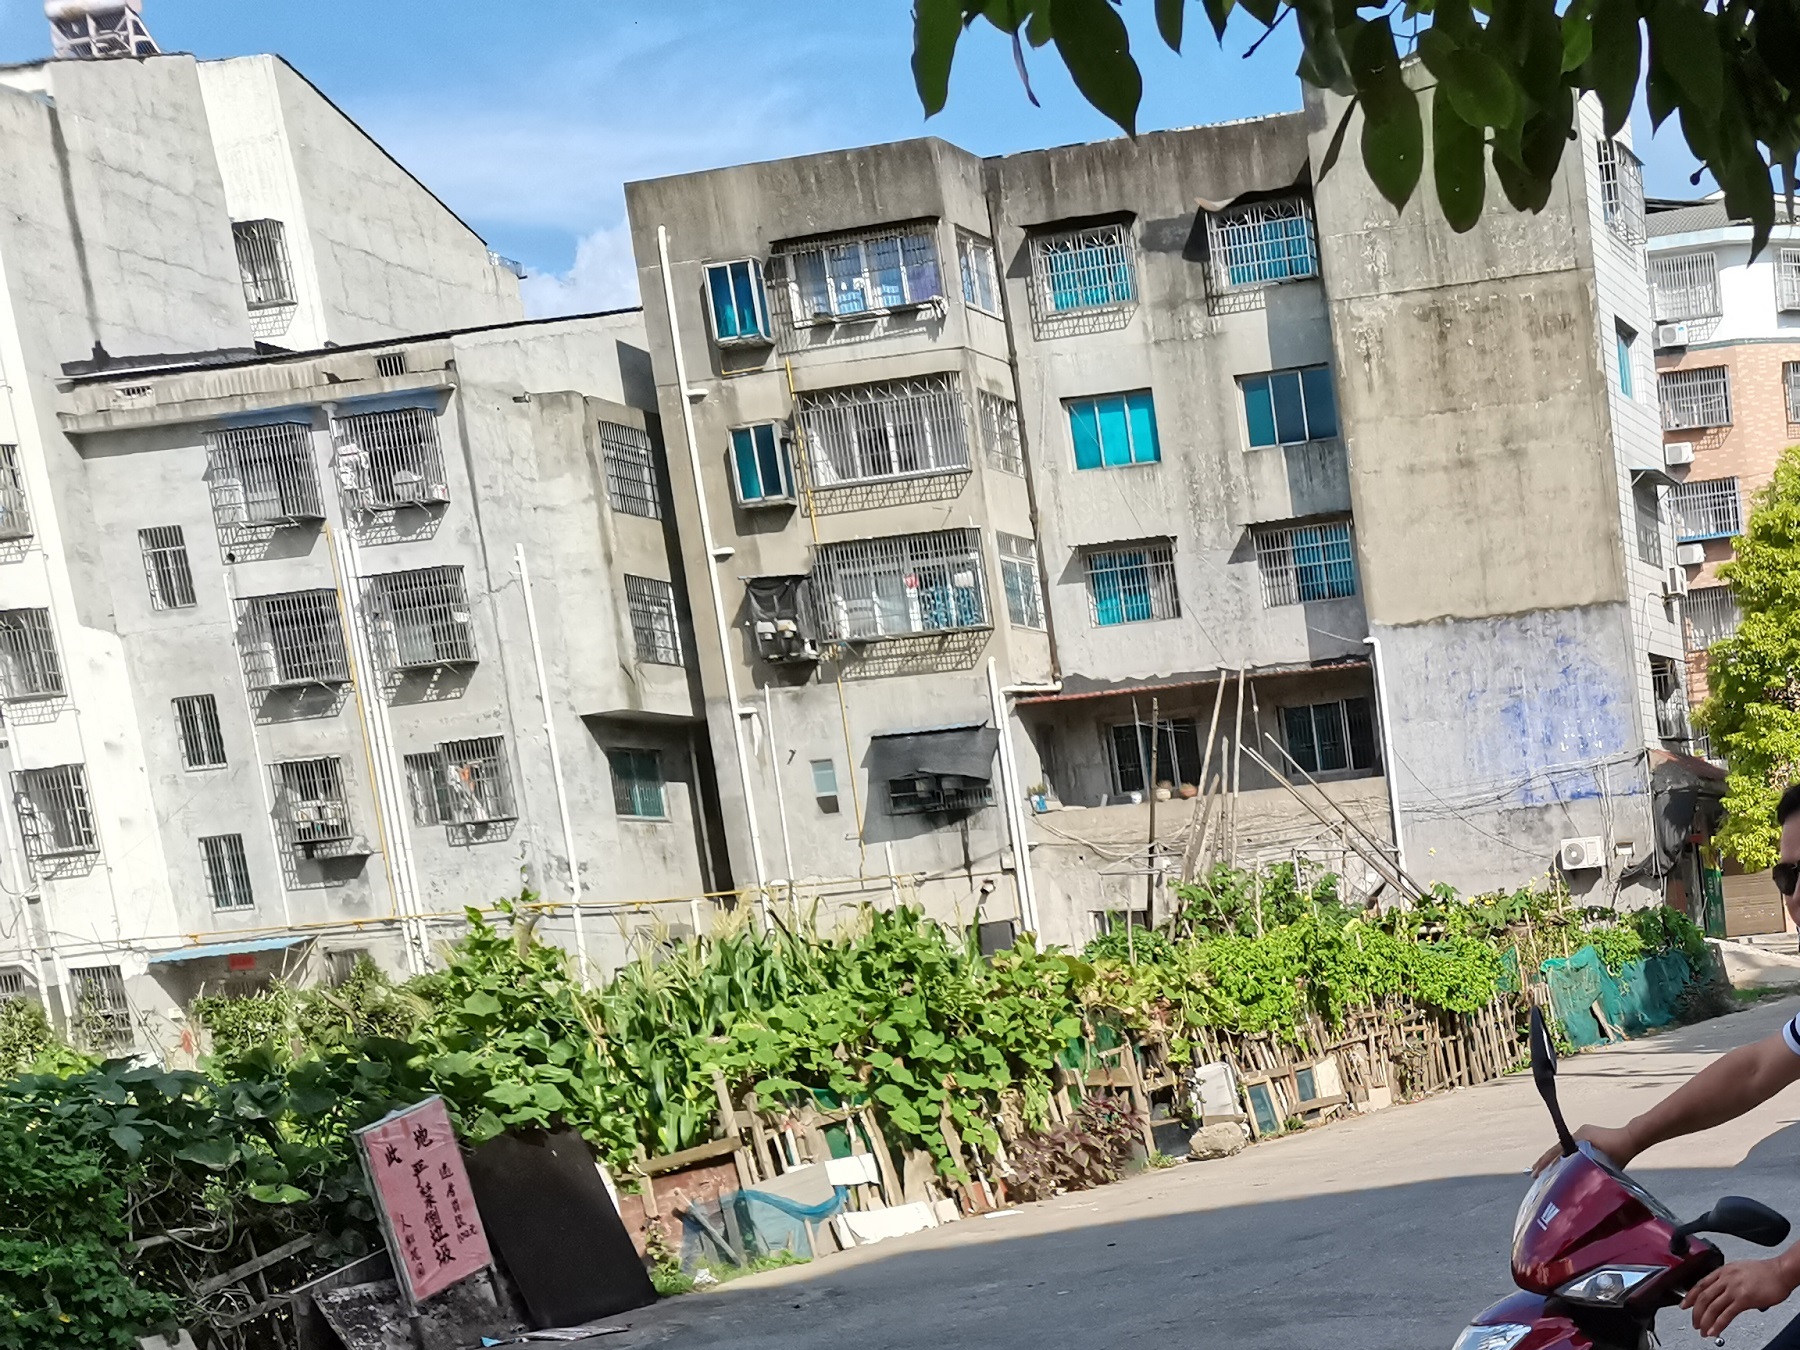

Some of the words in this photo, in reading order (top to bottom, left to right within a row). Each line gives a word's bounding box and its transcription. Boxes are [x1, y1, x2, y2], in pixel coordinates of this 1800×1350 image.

[411, 1158, 456, 1267] 严禁倒垃圾
